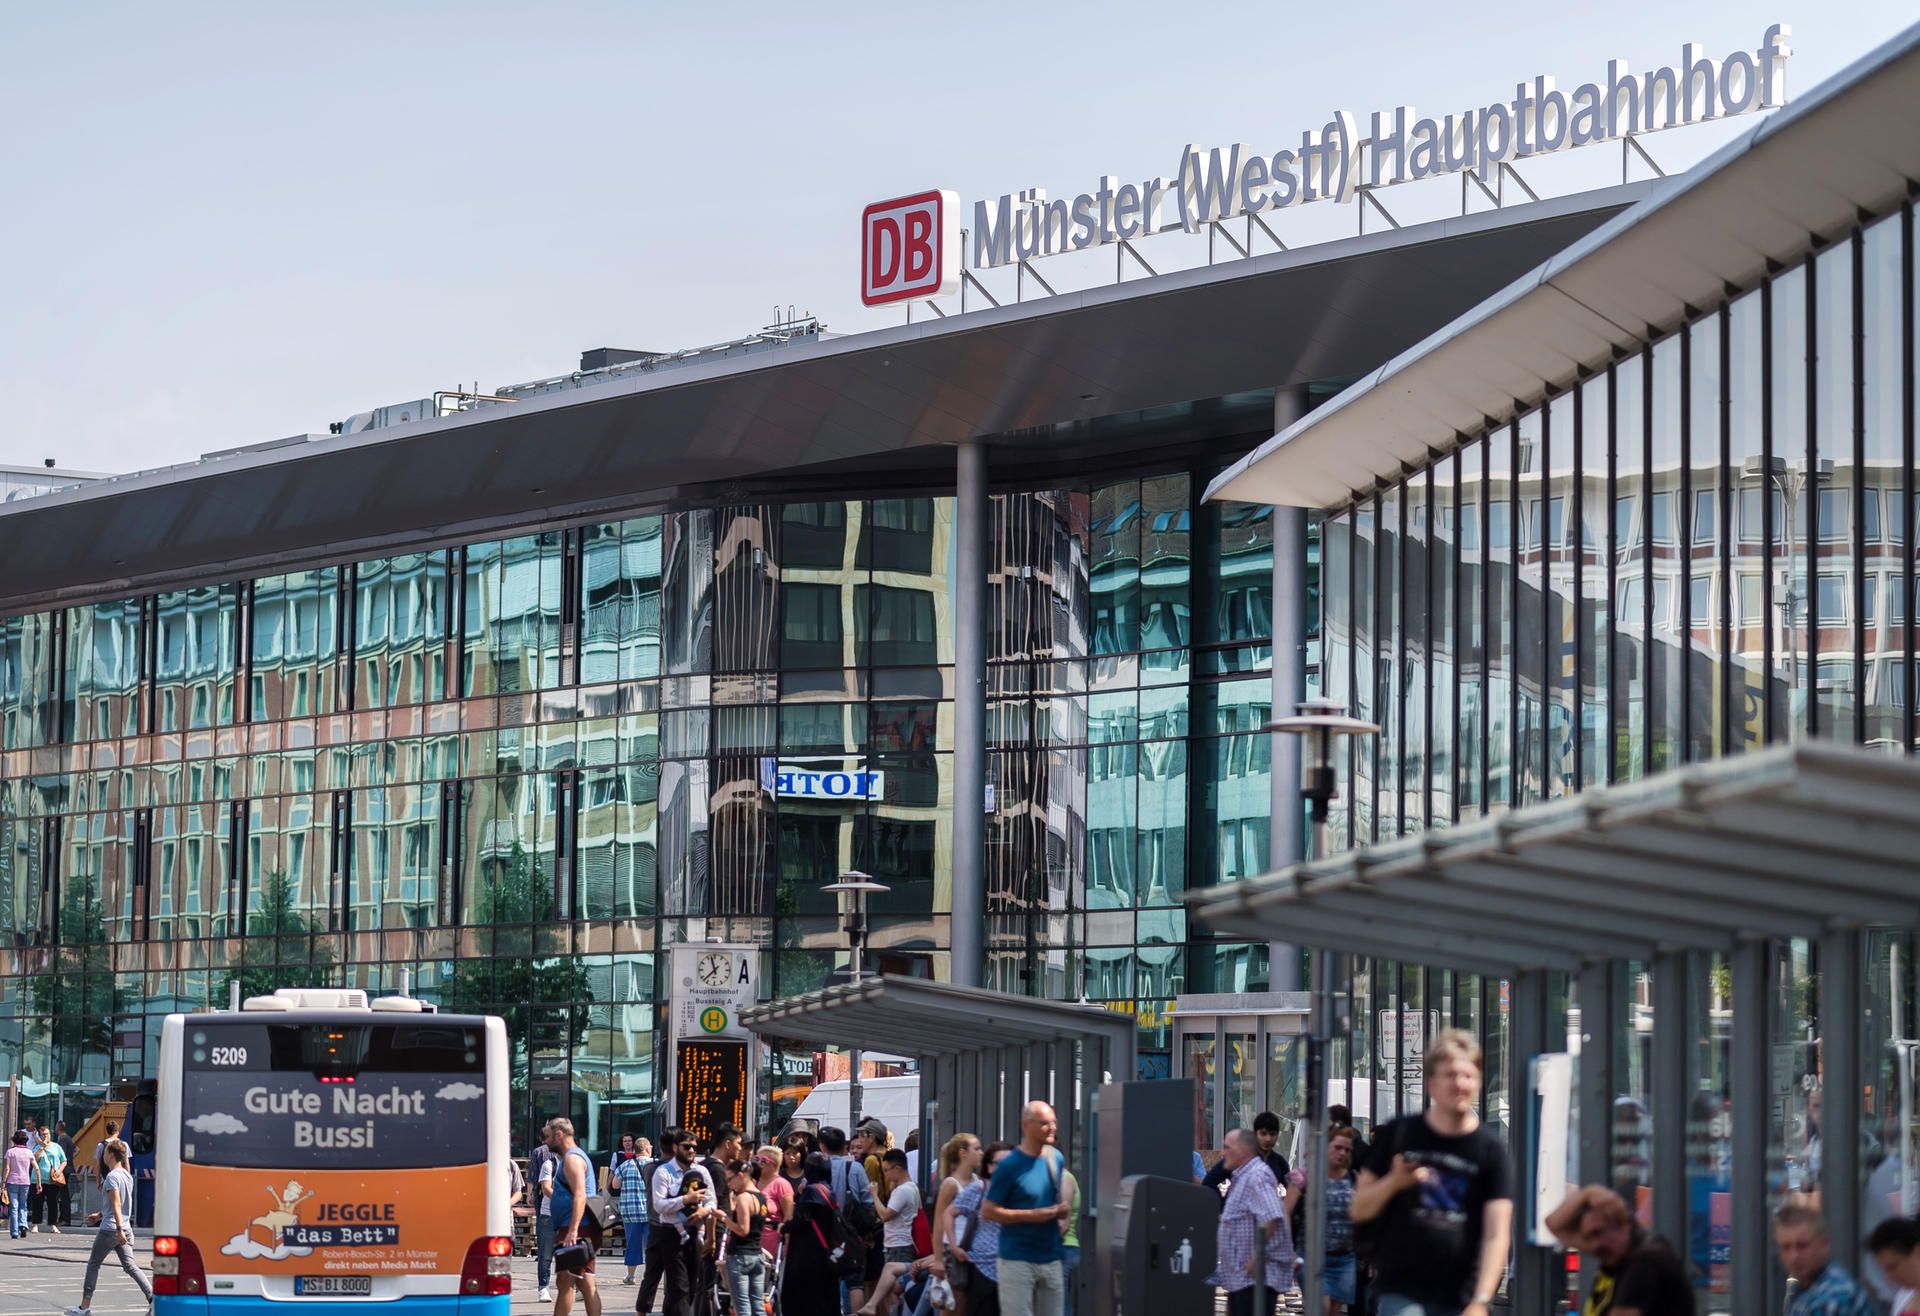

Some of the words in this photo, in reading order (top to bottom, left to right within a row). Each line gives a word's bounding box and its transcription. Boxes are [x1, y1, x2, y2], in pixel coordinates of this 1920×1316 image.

[973, 175, 1170, 269] Münster
[1178, 109, 1358, 234] (Westf)
[1371, 23, 1792, 184] Hauptbahnhof
[871, 209, 935, 290] DB
[737, 959, 750, 985] A
[689, 988, 739, 996] Hauptbahnhof
[708, 1012, 720, 1028] H
[211, 1047, 248, 1066] 5209
[244, 1086, 322, 1115] Gute
[333, 1087, 425, 1115] Nacht
[294, 1120, 374, 1149] Bussi
[316, 1203, 396, 1222] JEGGLE
[389, 1250, 395, 1258] 2
[397, 1250, 404, 1258] in
[406, 1249, 439, 1258] Münster
[324, 1260, 350, 1270] direkt
[352, 1260, 379, 1270] neben
[381, 1260, 408, 1270] Media
[410, 1260, 437, 1270] Markt
[303, 1279, 317, 1291] MS
[341, 1279, 369, 1291] 8000
